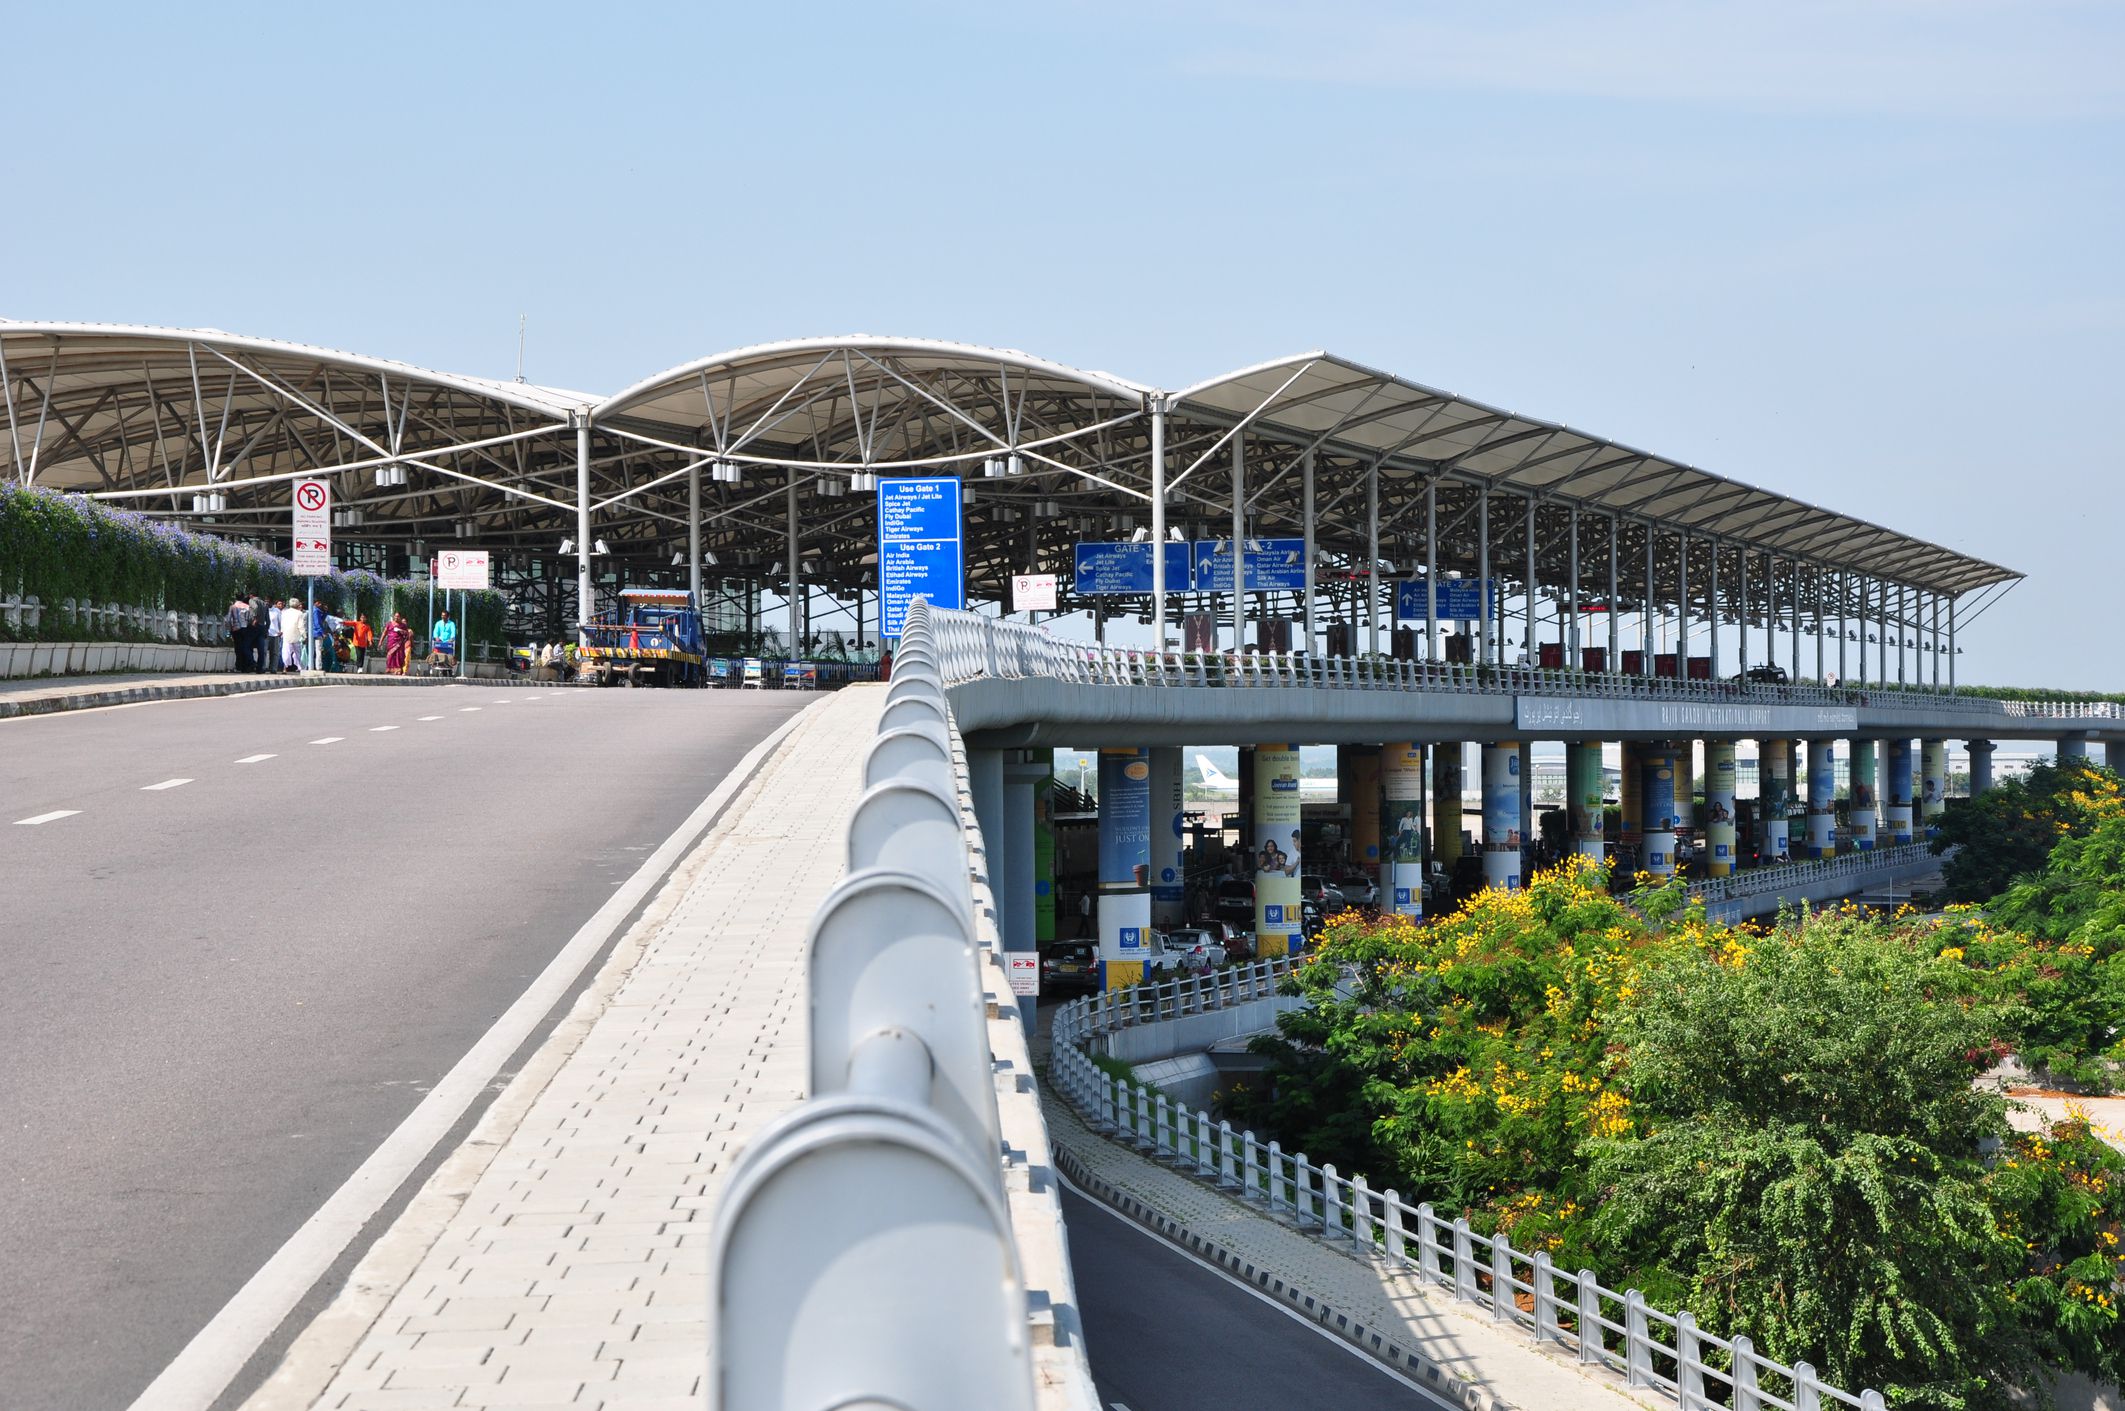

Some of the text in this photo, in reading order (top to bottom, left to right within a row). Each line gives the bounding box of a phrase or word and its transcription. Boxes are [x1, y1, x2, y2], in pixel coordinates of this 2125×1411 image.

[899, 484, 940, 492] Use Gate 1
[1116, 834, 1136, 845] JUST
